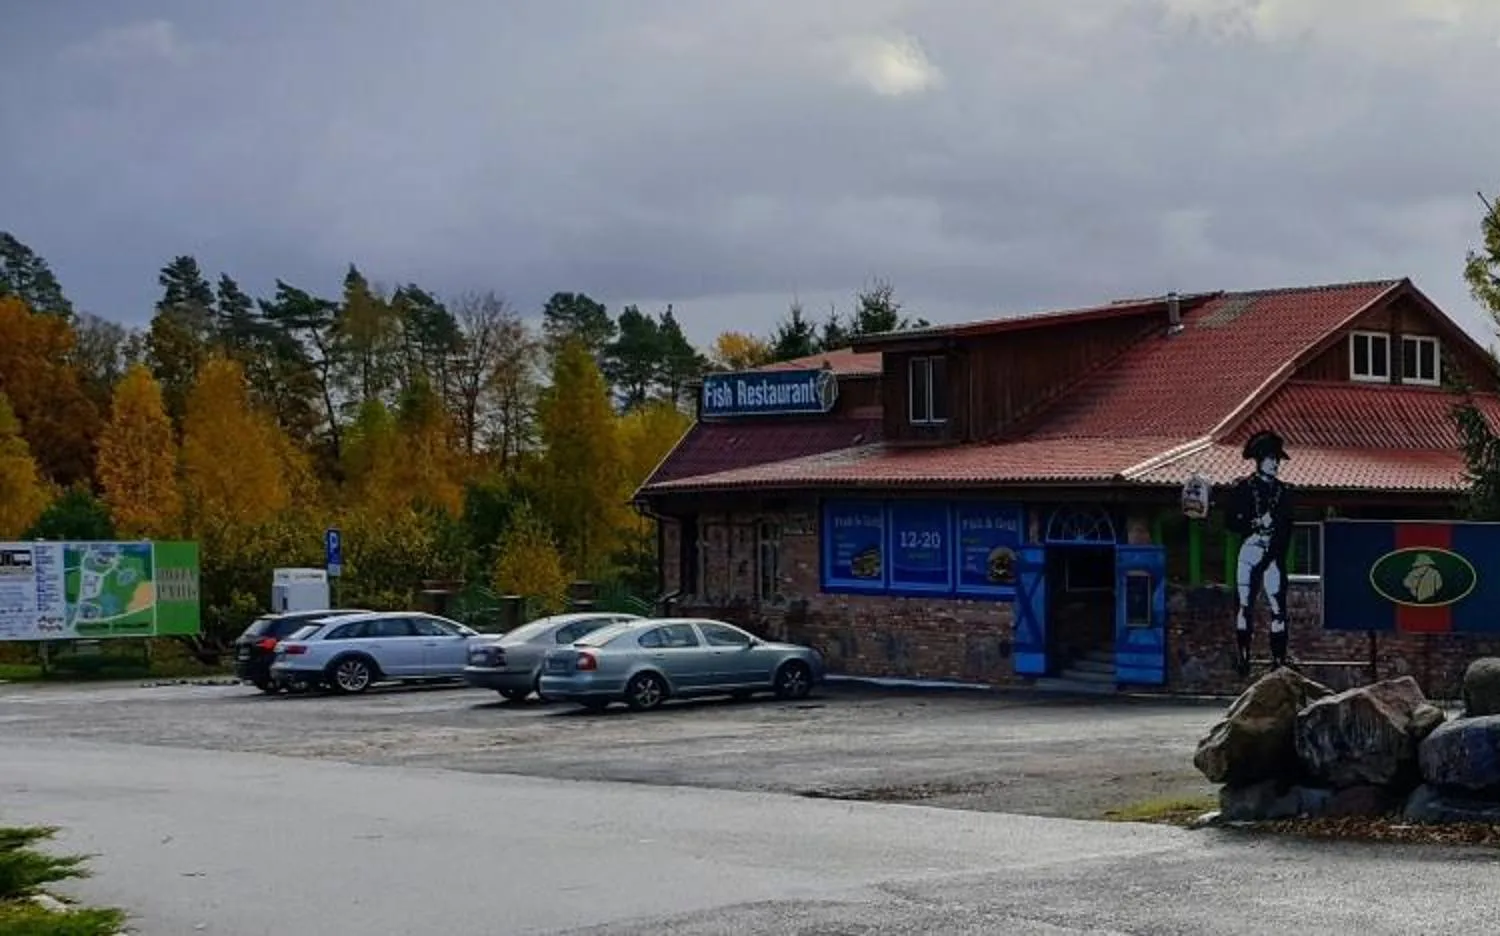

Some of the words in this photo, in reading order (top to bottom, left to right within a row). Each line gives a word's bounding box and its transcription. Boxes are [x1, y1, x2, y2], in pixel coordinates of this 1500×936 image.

[704, 381, 733, 408] Fish
[737, 377, 816, 407] Restaurant
[900, 530, 941, 549] 12-20
